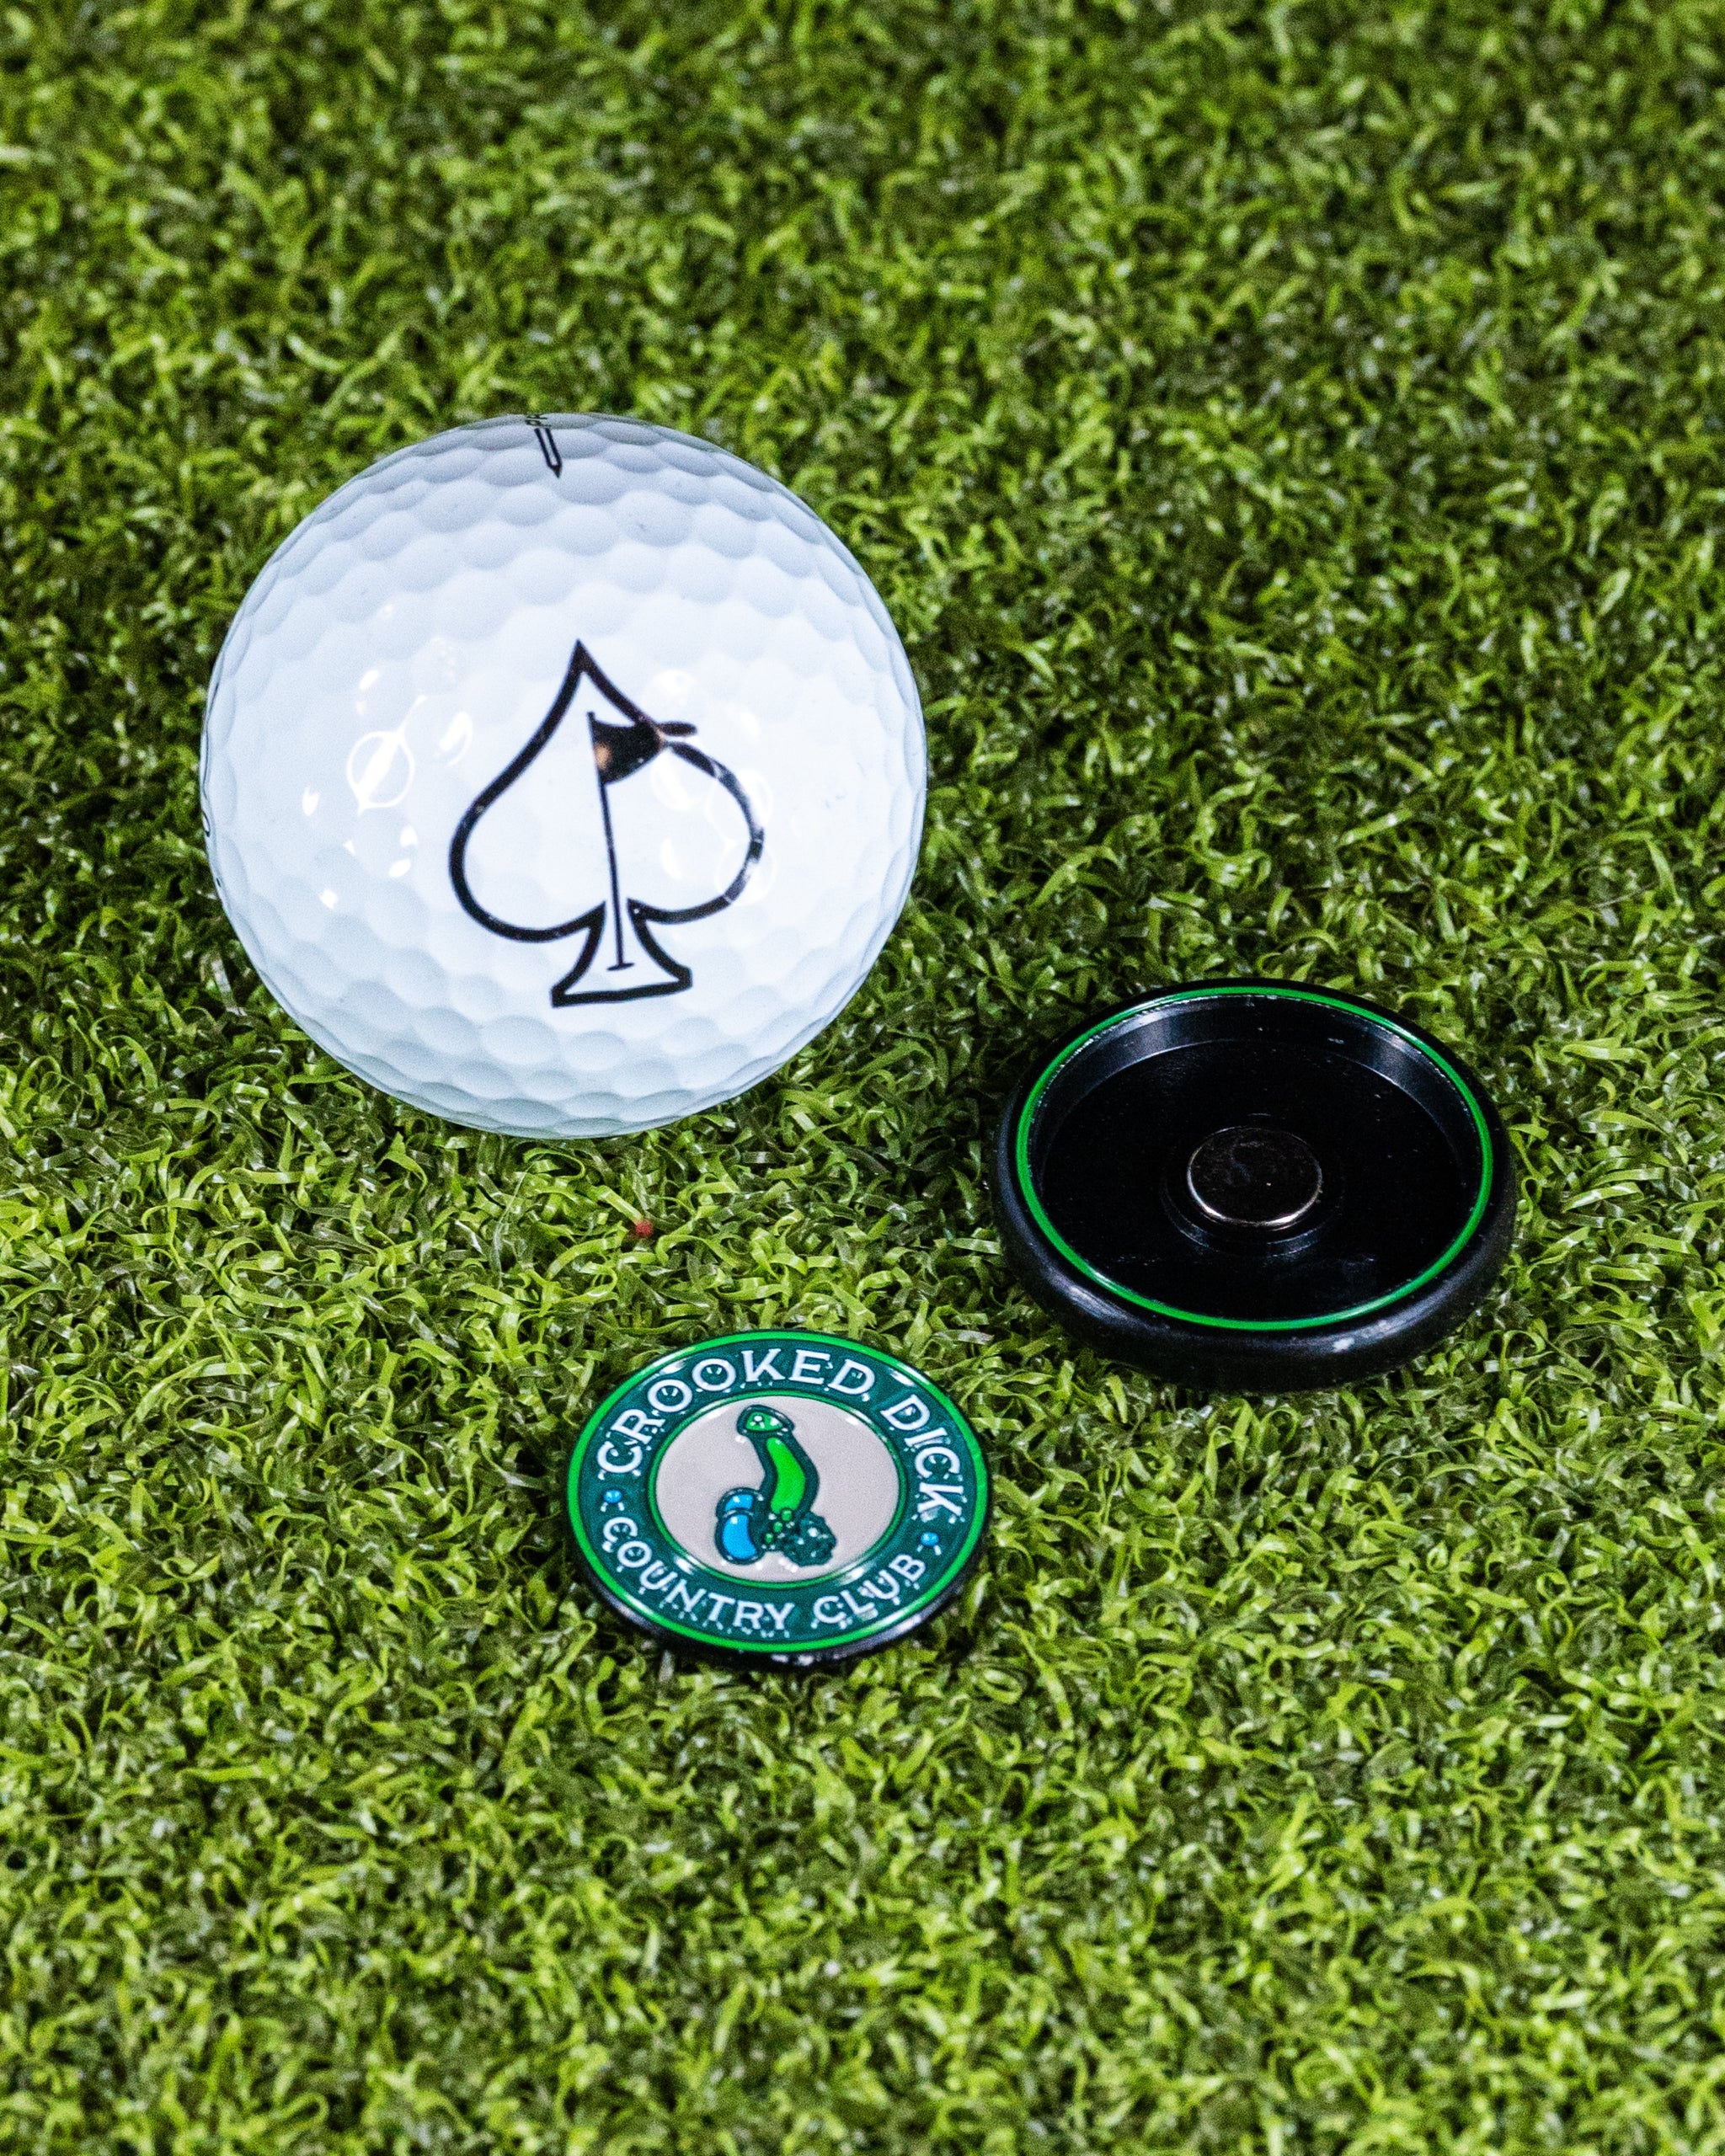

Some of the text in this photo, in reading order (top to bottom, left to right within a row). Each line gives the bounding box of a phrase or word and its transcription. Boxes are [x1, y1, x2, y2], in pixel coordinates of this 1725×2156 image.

[596, 1348, 965, 1521] CROOKED DICK
[602, 1517, 927, 1631] COUNTRY CLUB
